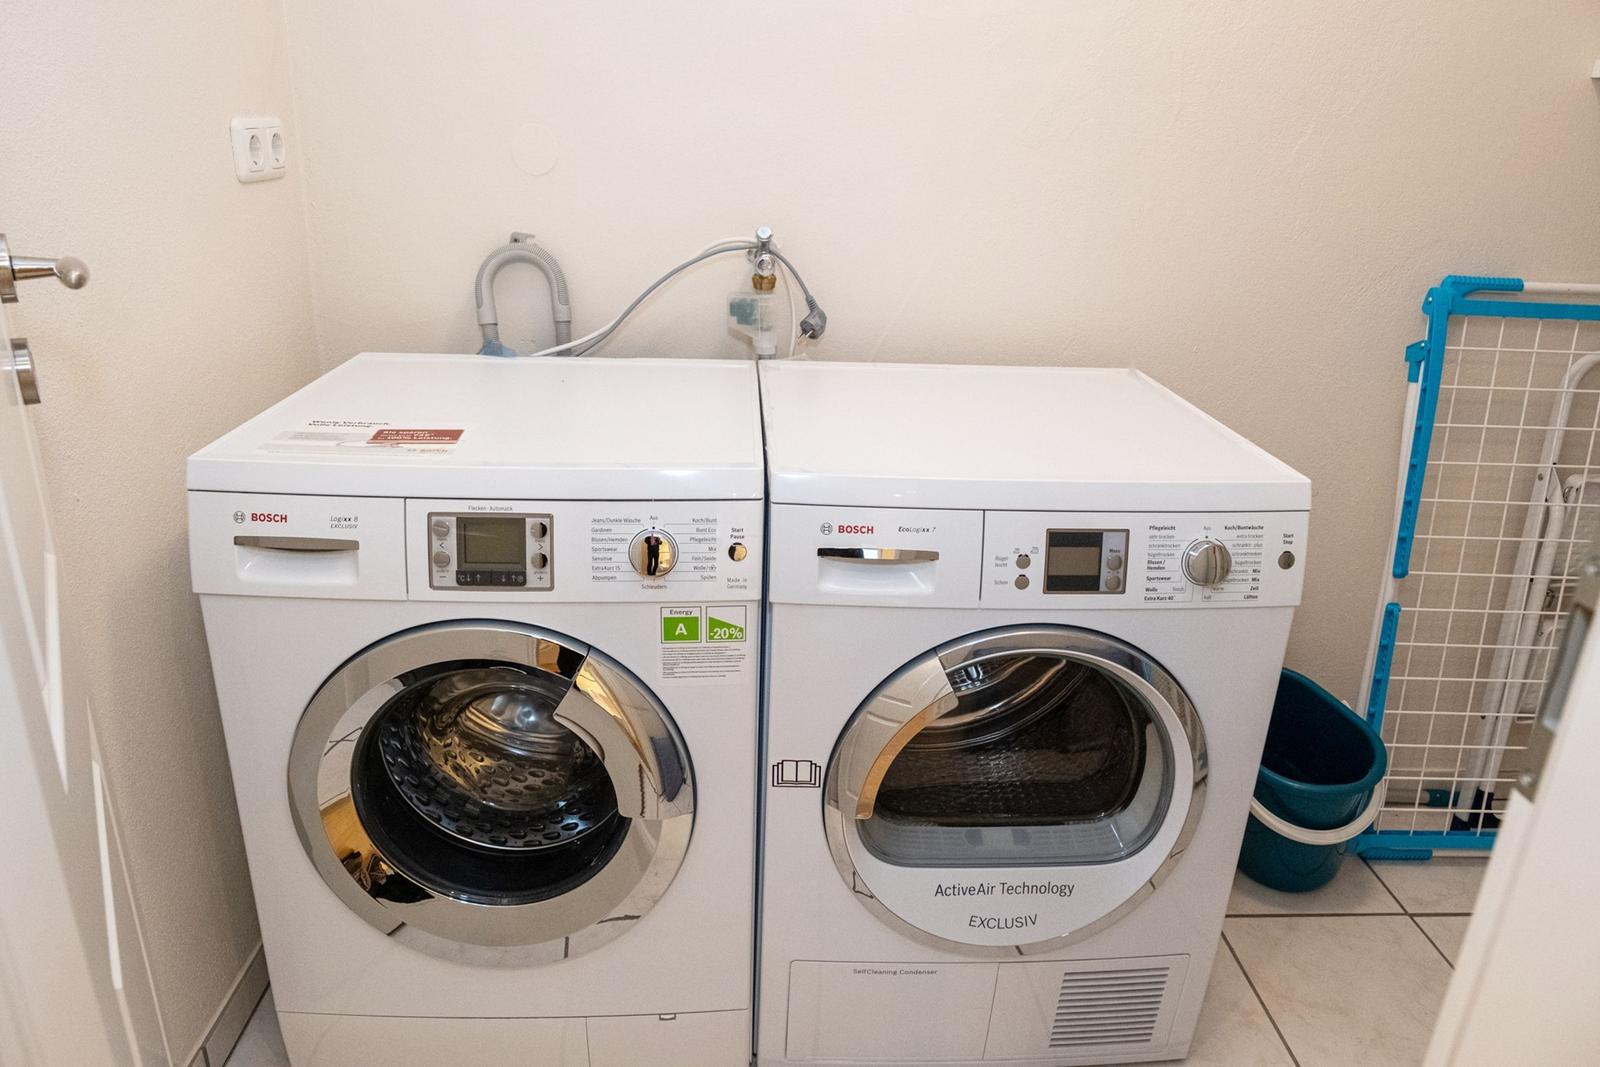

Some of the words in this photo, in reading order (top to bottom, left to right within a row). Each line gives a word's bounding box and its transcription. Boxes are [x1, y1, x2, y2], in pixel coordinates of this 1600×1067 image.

[251, 512, 288, 524] BOSCH
[838, 524, 875, 535] BOSCH
[675, 623, 688, 636] A
[709, 627, 743, 639] -20%
[934, 883, 996, 898] ActiveAir
[999, 881, 1075, 898] Technology
[968, 913, 1038, 930] EXCLUSIV
[852, 968, 898, 976] SelfCleaning
